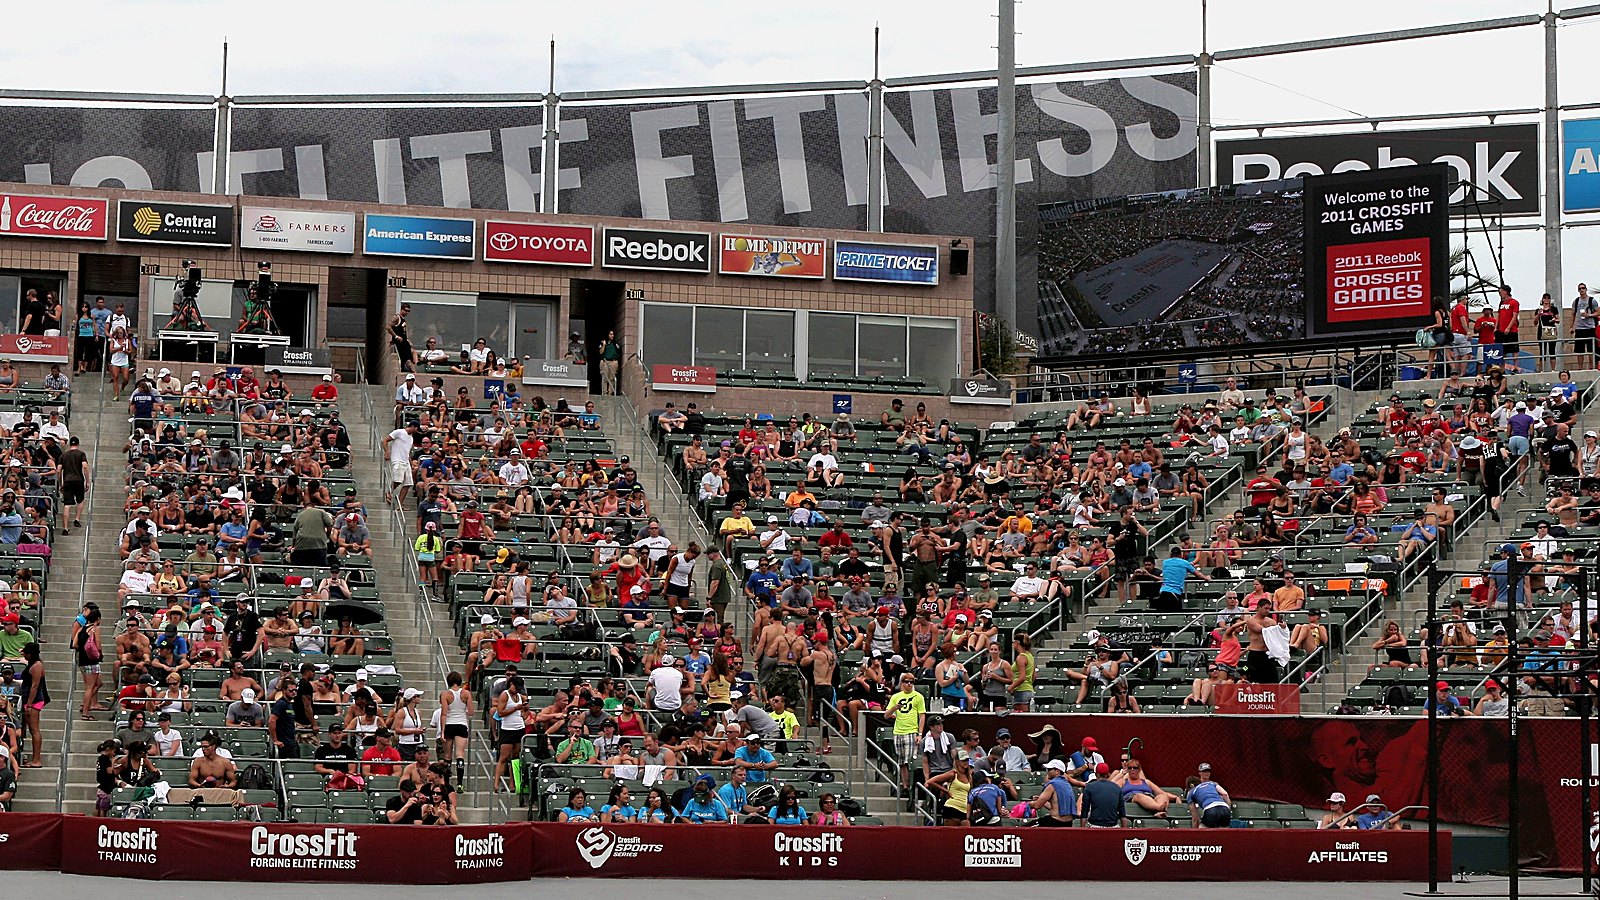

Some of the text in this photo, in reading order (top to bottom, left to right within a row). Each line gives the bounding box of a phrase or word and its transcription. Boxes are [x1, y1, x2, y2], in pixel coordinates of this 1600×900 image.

[1325, 185, 1430, 205] Welcome to the
[16, 203, 98, 232] Coca-Cola
[1321, 201, 1434, 223] 2011 CROSSFIT
[165, 213, 216, 229] Central
[289, 223, 346, 233] FARMERS
[1350, 219, 1404, 234] GAMES
[368, 228, 472, 244] American Express
[519, 236, 588, 252] TOYOTA
[609, 236, 705, 262] Reebok
[771, 240, 822, 256] DEPOT
[1335, 251, 1421, 268] 2011 Reebok
[1334, 270, 1422, 288] CROSSFIT
[1334, 284, 1423, 305] GAMES
[283, 350, 313, 360] CrossFit
[542, 364, 568, 373] CrossFit
[671, 368, 698, 377] CrossFit
[1238, 691, 1276, 703] CrossFit
[98, 824, 158, 850] CrossFit
[251, 826, 358, 857] CrossFit
[455, 832, 504, 857] CrossFit
[617, 836, 641, 844] CrossFit
[774, 831, 843, 853] CrossFit
[964, 834, 1022, 853] CrossFit
[614, 843, 664, 852] SPORTS
[1172, 846, 1222, 854] RETENTION
[1335, 841, 1360, 850] CrossFit
[98, 851, 157, 864] TRAINING
[250, 858, 357, 869] FORGING ELITE FITNESS
[455, 858, 504, 869] TRAINING
[779, 856, 838, 867] KIDS
[971, 857, 1015, 865] JOURNAL
[1171, 854, 1202, 862] GROUP
[1308, 851, 1388, 863] AFFILIATES
